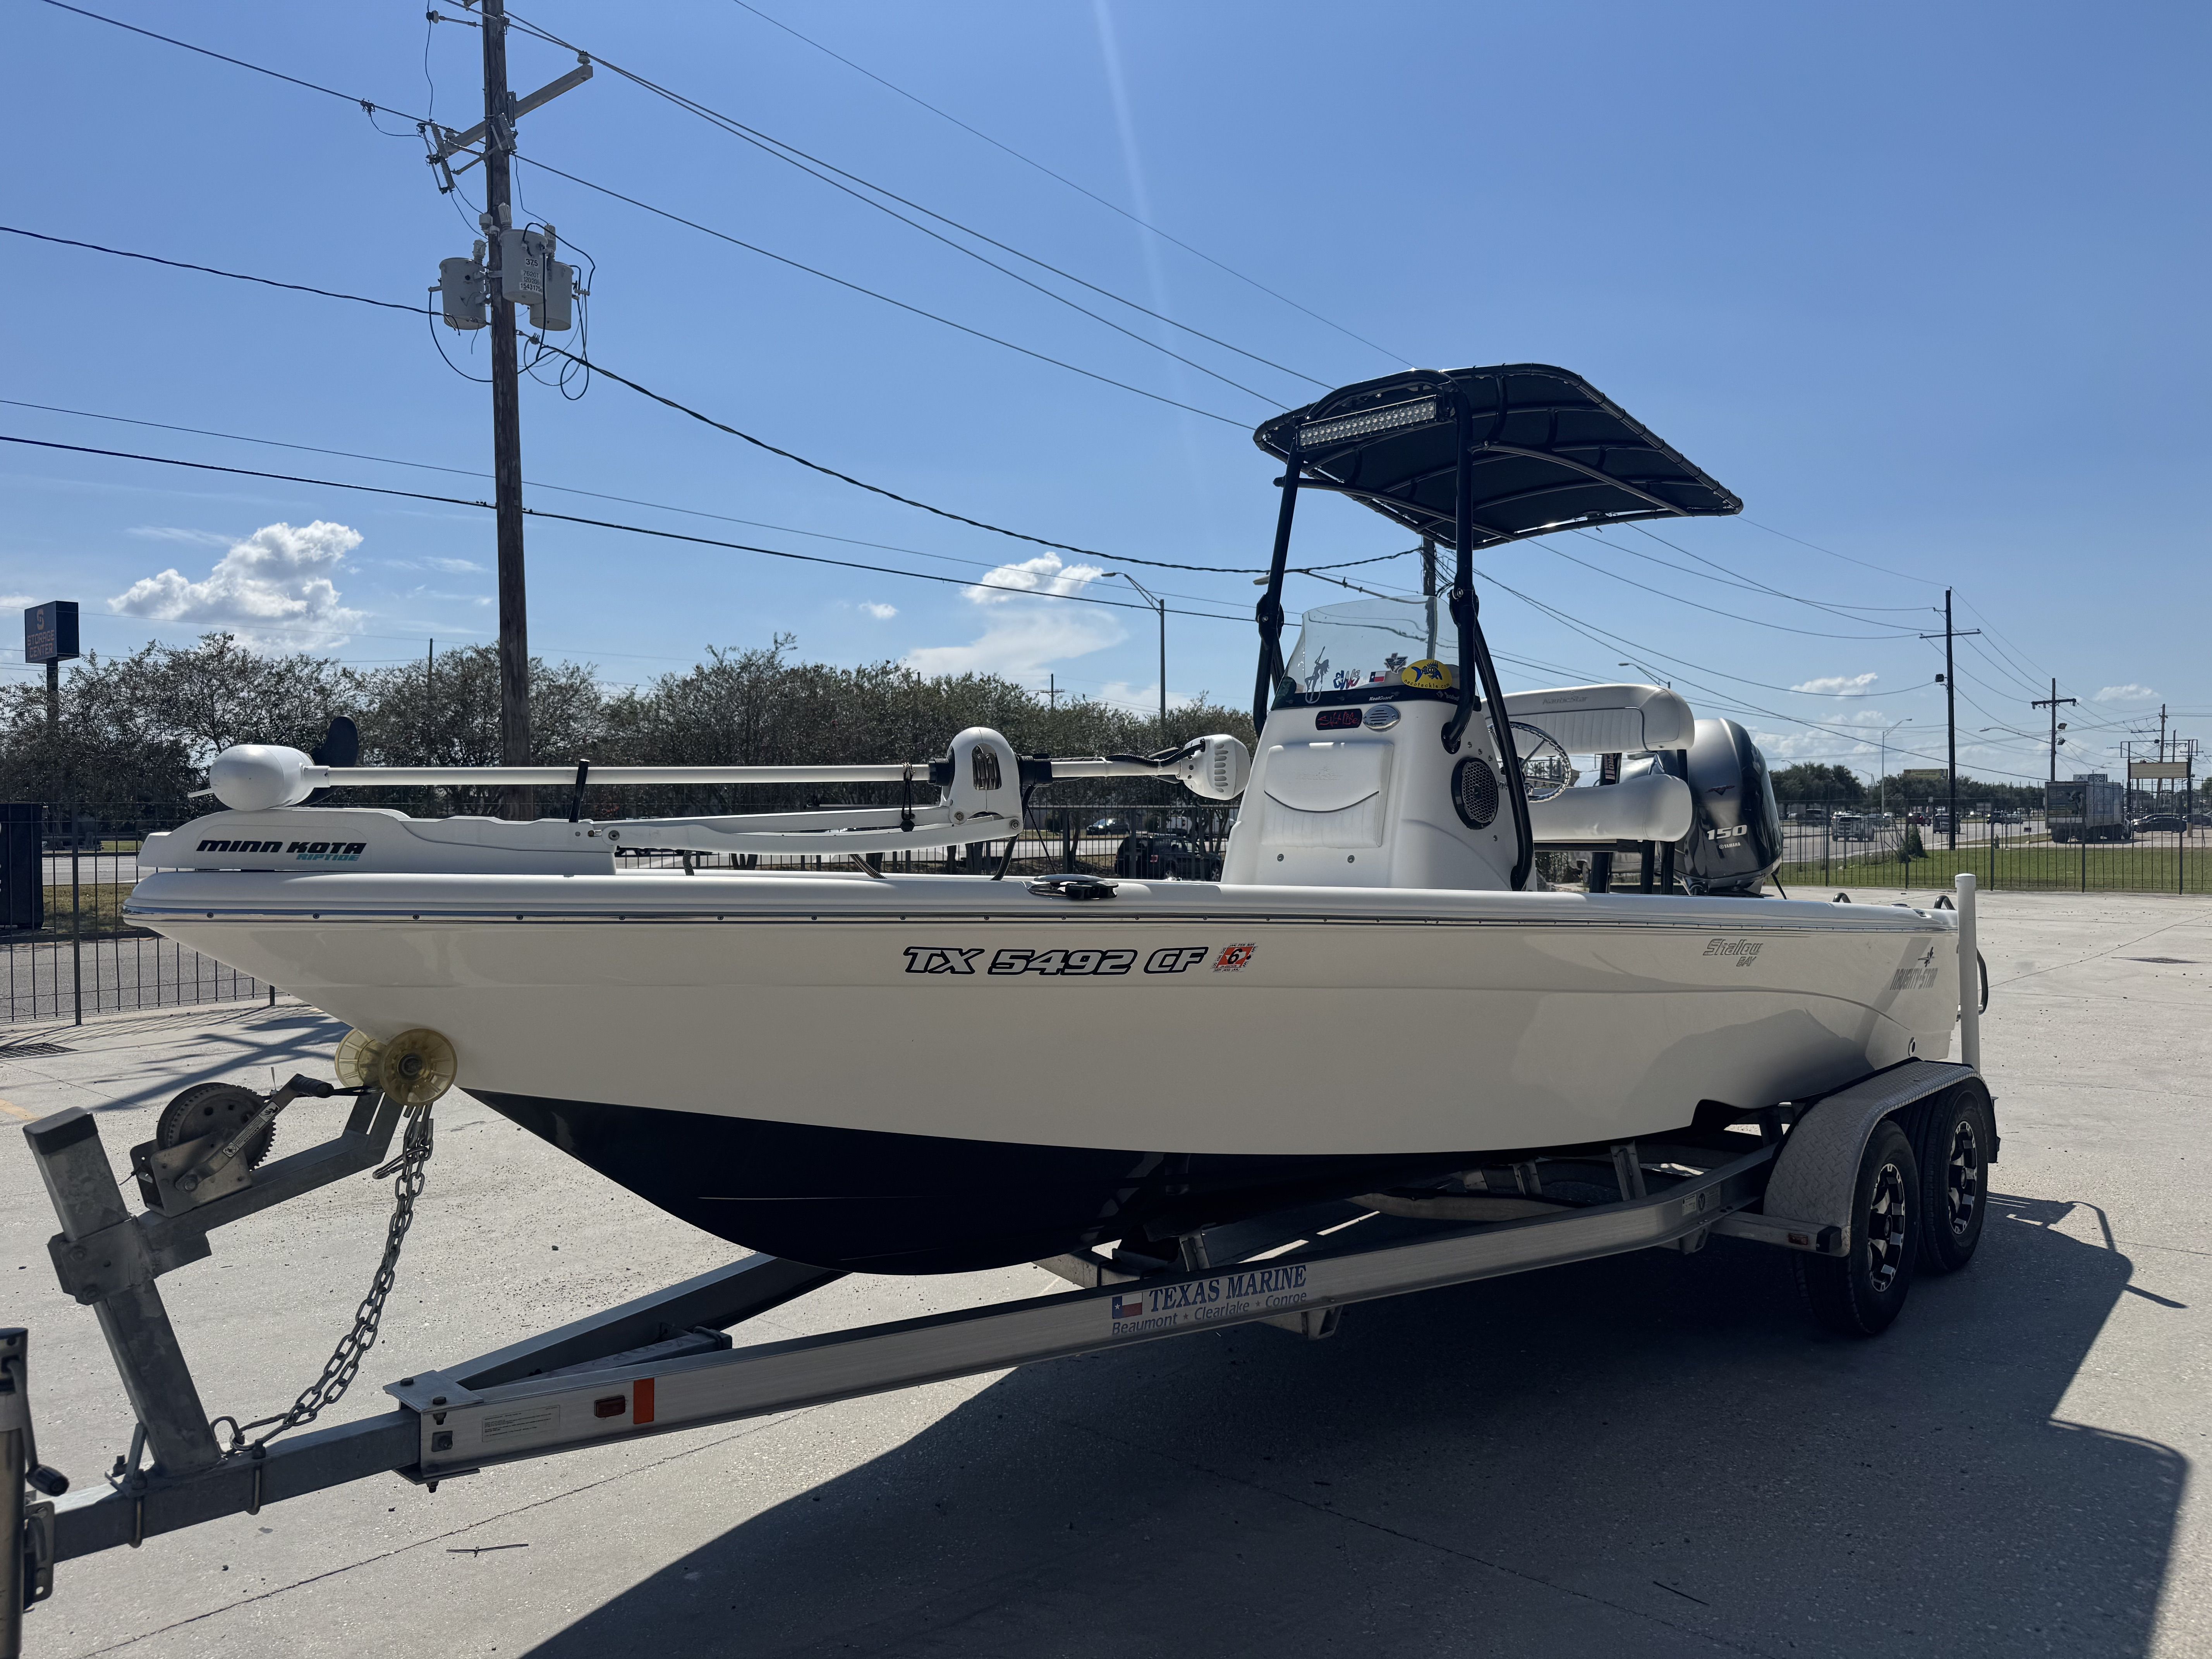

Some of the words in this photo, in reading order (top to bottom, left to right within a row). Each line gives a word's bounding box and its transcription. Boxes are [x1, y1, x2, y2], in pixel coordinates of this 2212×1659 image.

[27, 630, 55, 646] STORAGE
[29, 643, 53, 658] CENTER
[1707, 824, 1747, 840] 150
[286, 842, 367, 854] KOTA
[1703, 938, 1764, 956] Shallow
[903, 946, 985, 974] TX
[987, 949, 1138, 975] 5492
[1143, 946, 1209, 974] CF
[1227, 948, 1243, 964] 6
[1736, 956, 1757, 967] BAY
[1149, 1279, 1220, 1312] TEXAS
[1226, 1264, 1307, 1299] MARINE
[1112, 1312, 1178, 1336] Beaumont
[1194, 1302, 1250, 1321] Clearlake
[1265, 1292, 1307, 1308] Conroe
